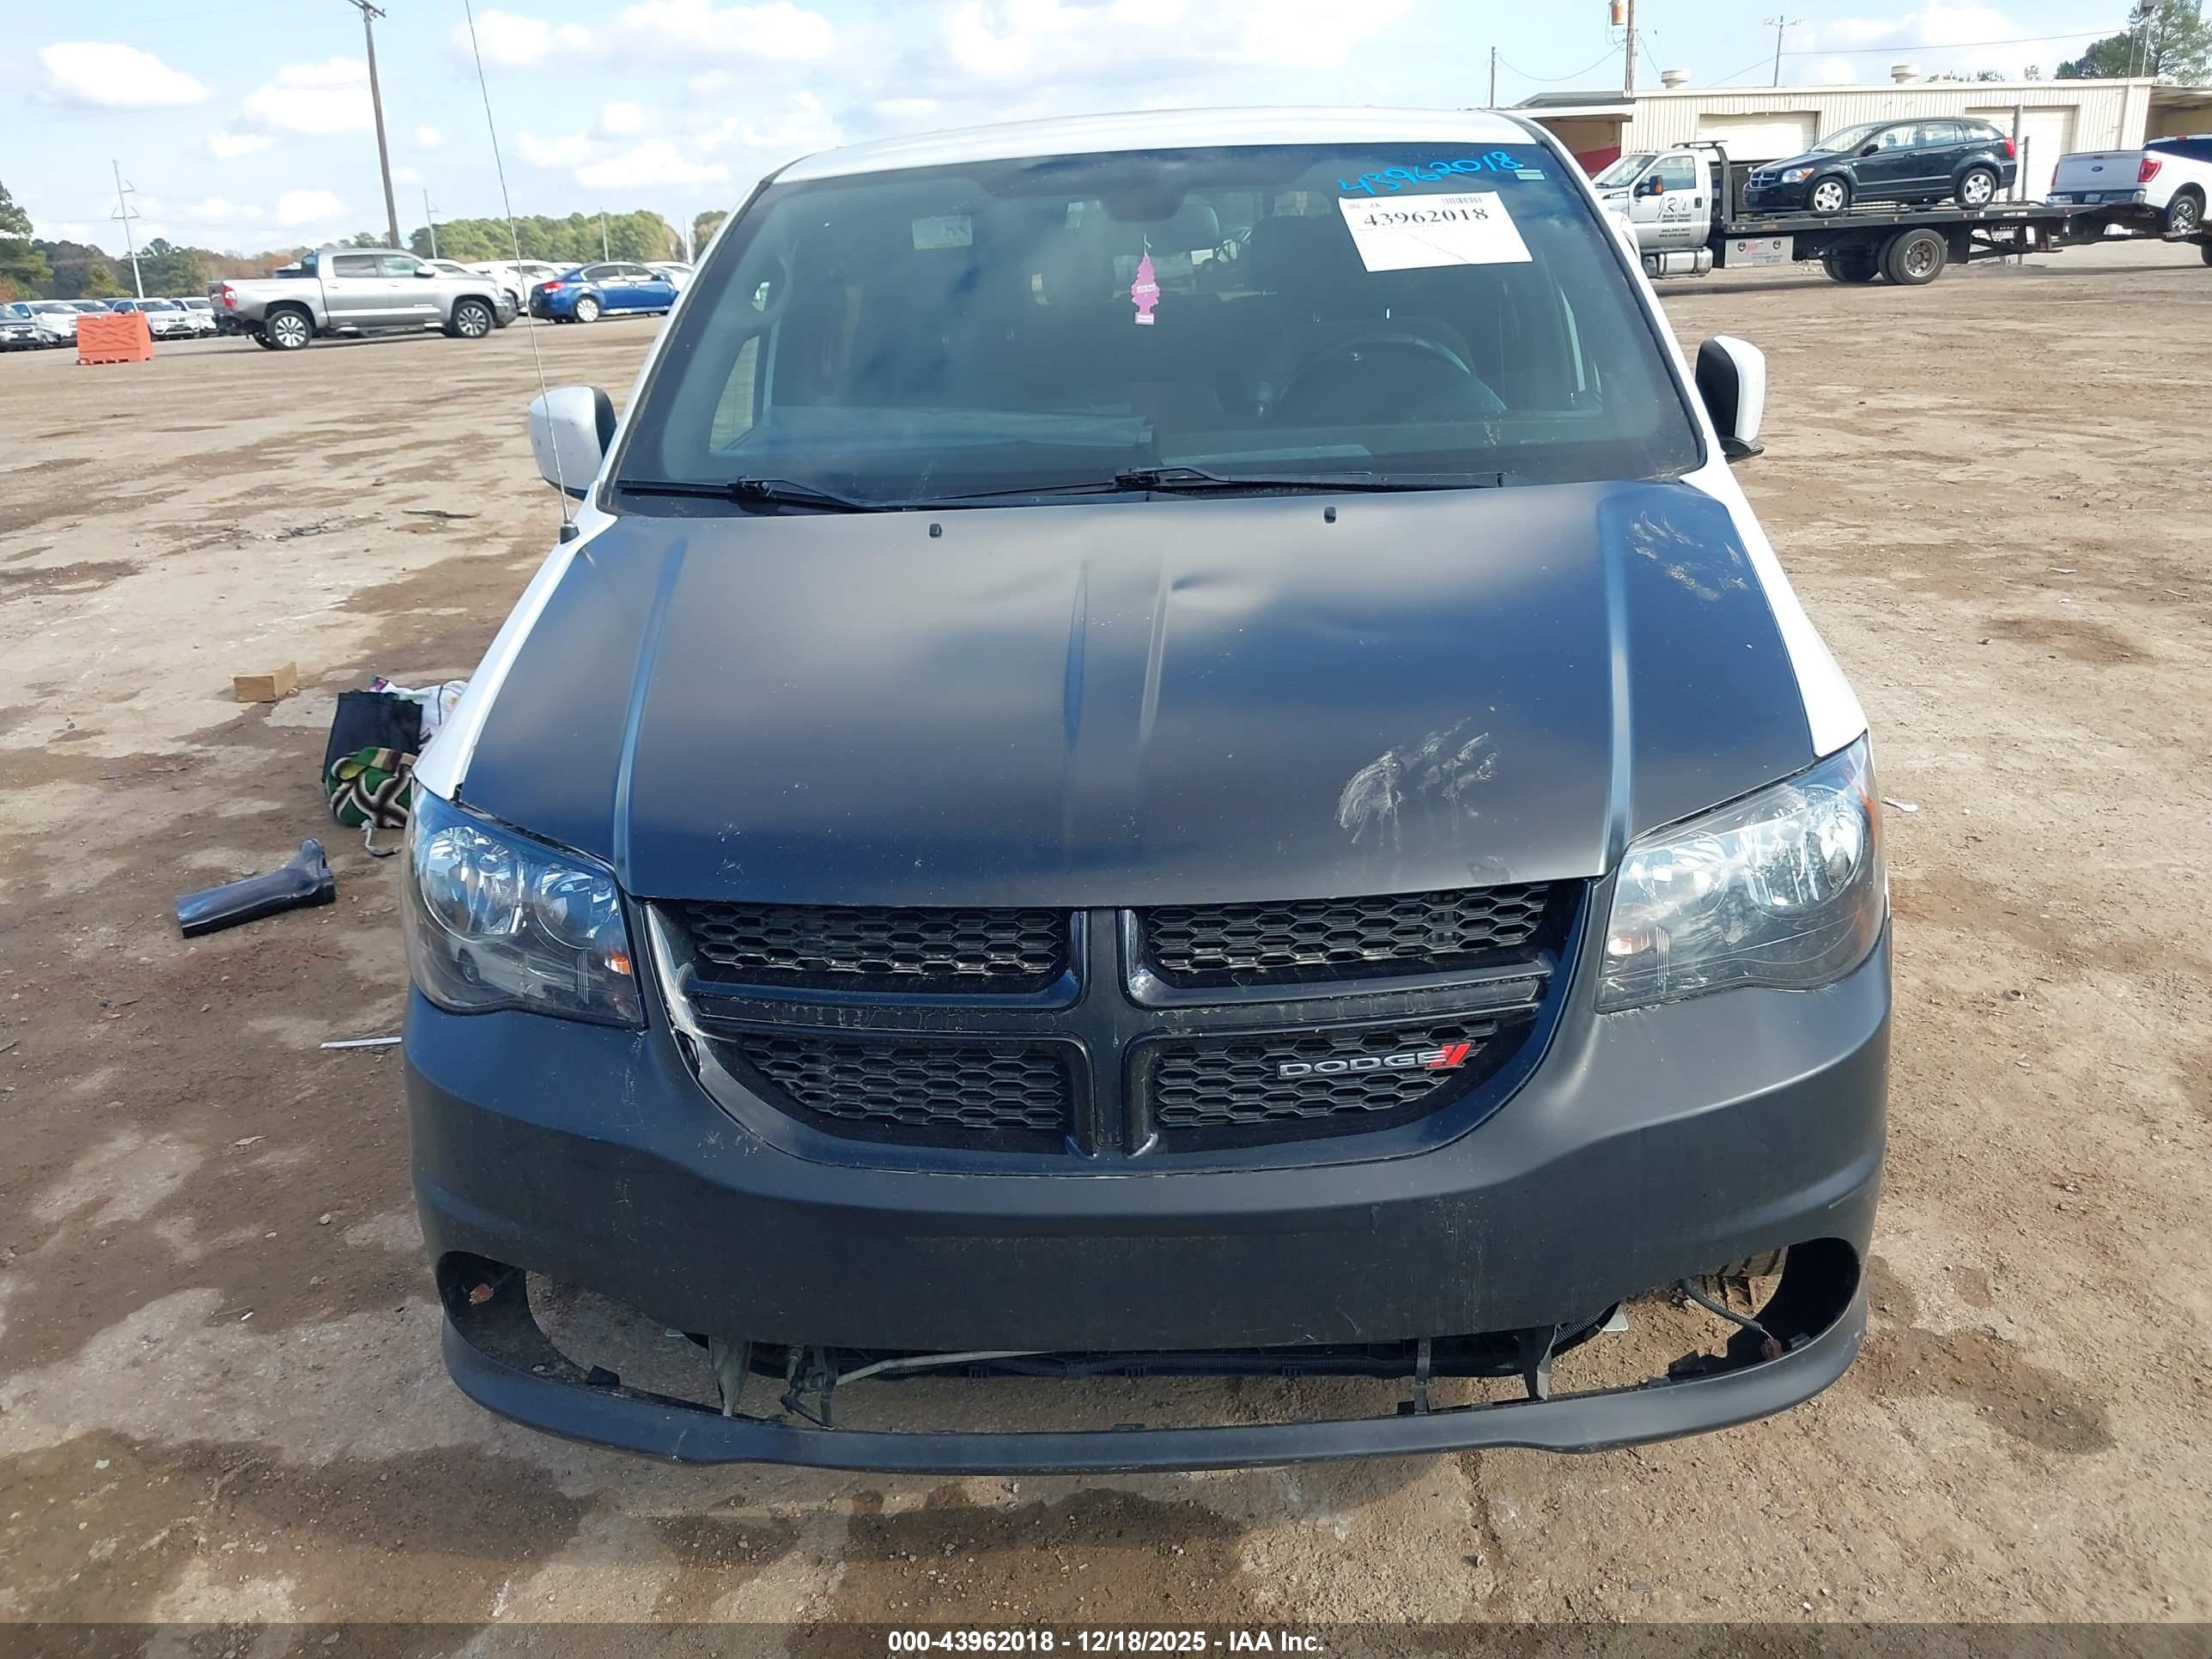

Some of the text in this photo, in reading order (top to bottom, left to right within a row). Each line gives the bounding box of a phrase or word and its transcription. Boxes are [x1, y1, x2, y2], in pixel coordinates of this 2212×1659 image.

[1339, 150, 1523, 195] 43962018
[1364, 208, 1489, 226] 43962018
[1279, 1049, 1447, 1077] DODGE
